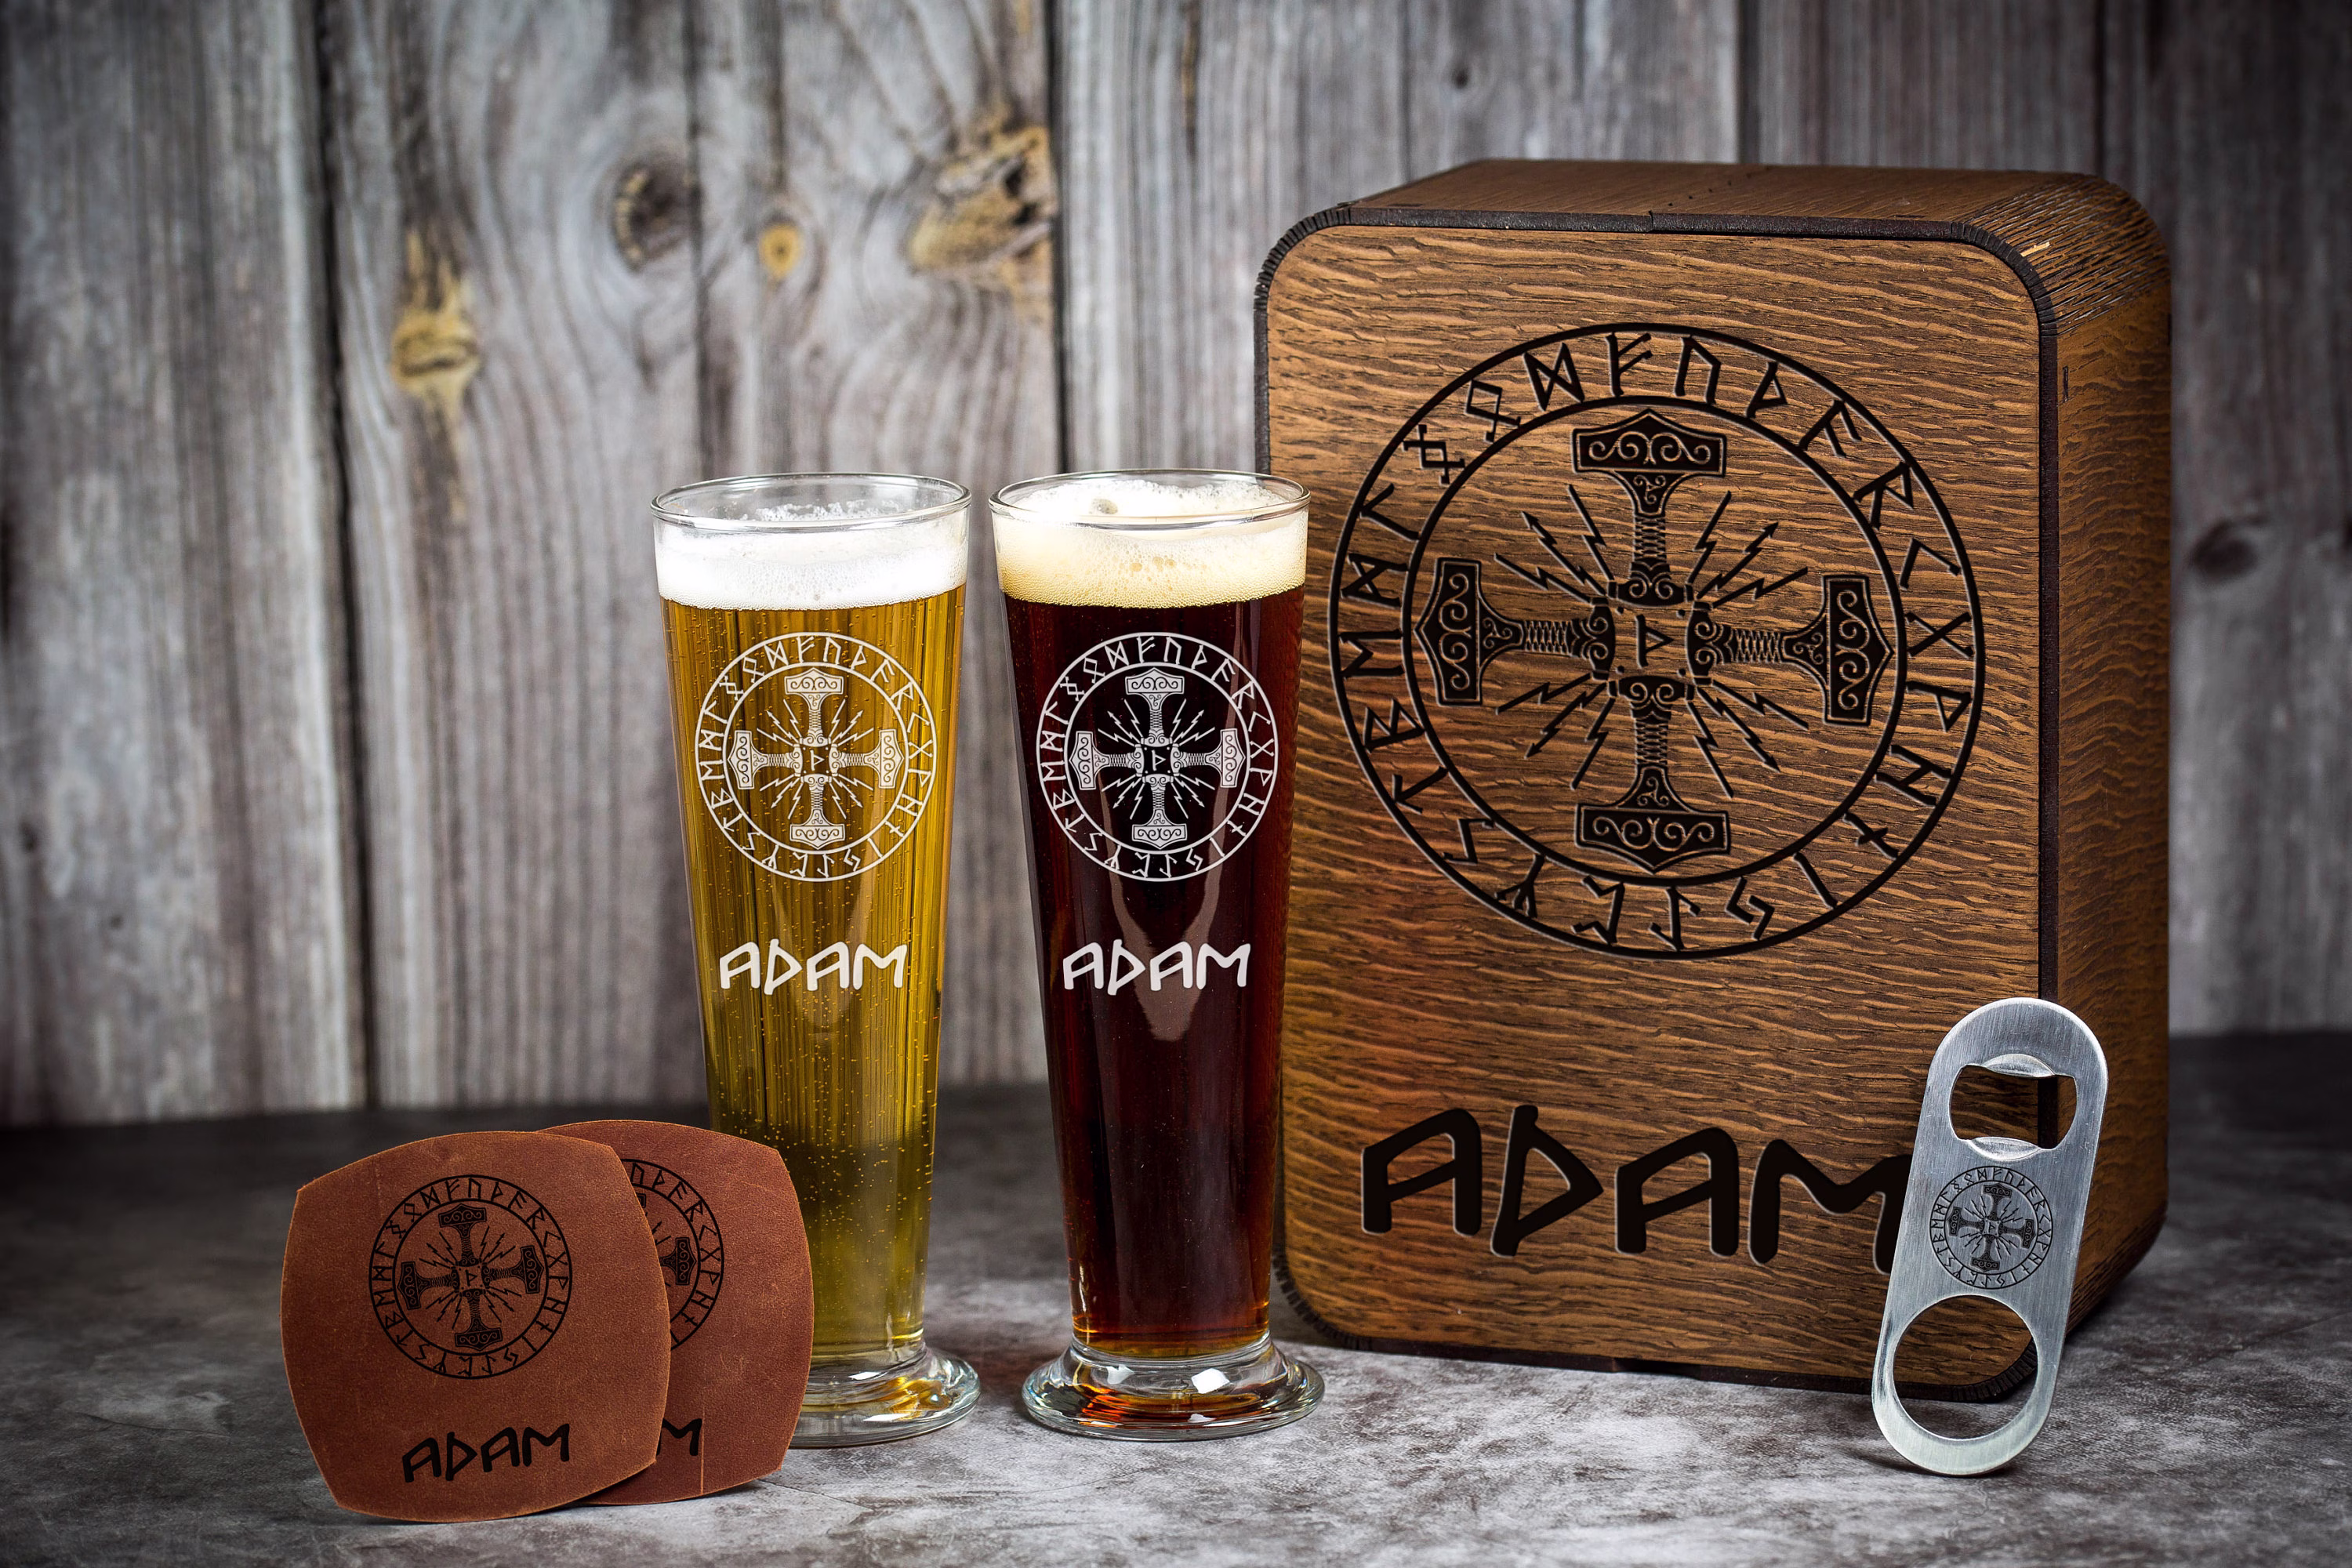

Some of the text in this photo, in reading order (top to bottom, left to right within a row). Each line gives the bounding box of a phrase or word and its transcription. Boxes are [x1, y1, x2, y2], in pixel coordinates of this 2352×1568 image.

[720, 938, 907, 996] ADAM
[1063, 939, 1251, 996] ADAM
[1361, 1104, 1913, 1273] ADAM
[402, 1422, 571, 1483] ADAM
